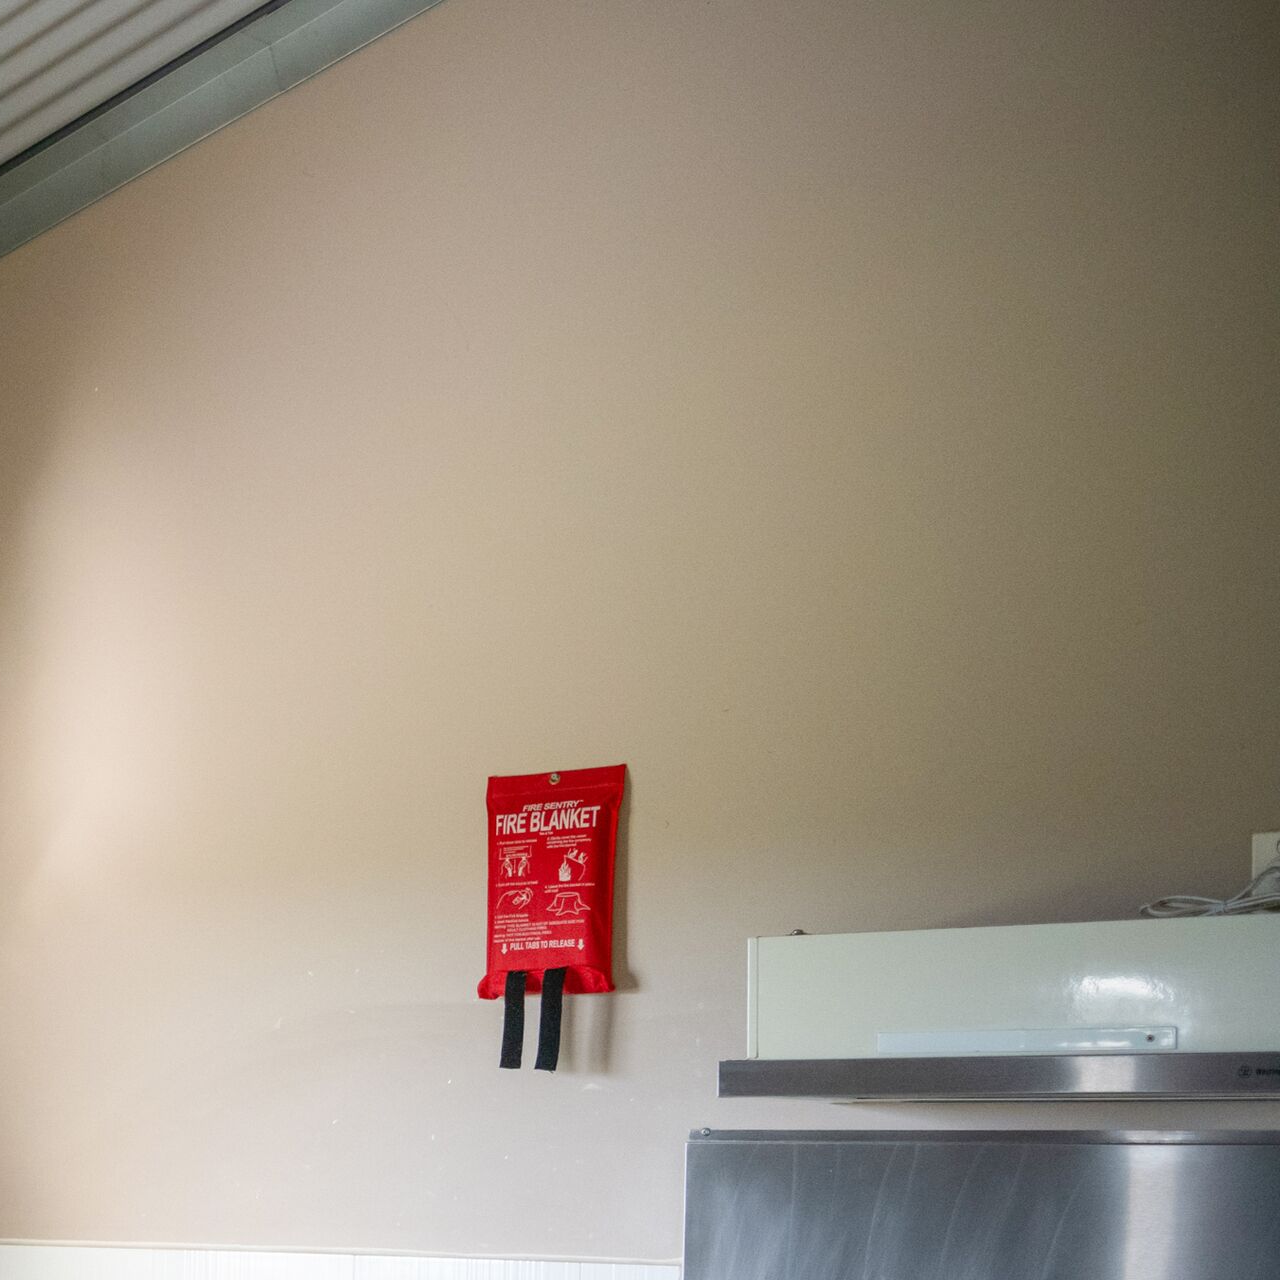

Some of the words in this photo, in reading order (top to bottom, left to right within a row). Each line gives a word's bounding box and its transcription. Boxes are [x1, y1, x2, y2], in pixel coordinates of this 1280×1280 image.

[523, 803, 542, 812] FIRE
[544, 800, 580, 810] SENTRY
[496, 813, 528, 836] FIRE
[529, 805, 601, 833] BLANKET
[509, 941, 524, 951] PULL
[525, 940, 540, 950] TABS
[540, 940, 549, 949] TO
[549, 939, 576, 948] RELEASE
